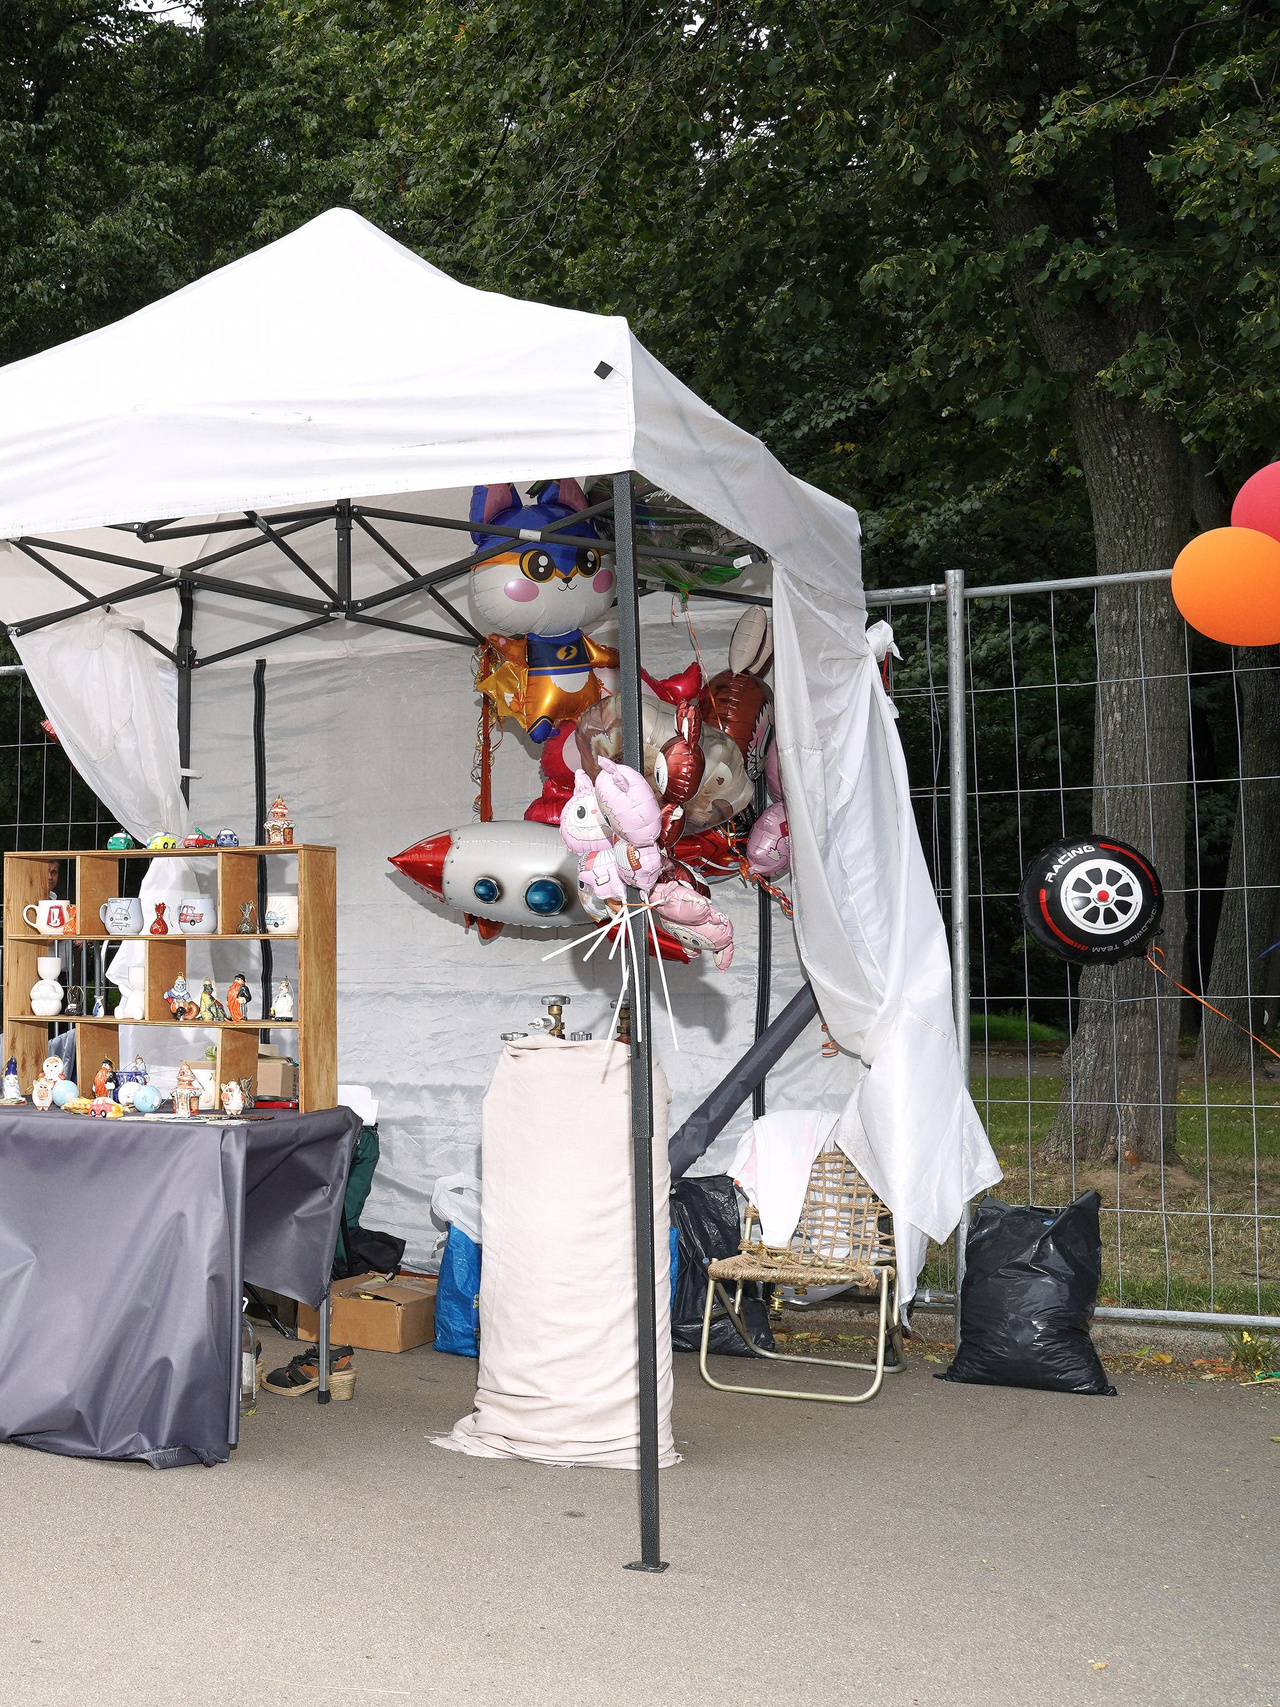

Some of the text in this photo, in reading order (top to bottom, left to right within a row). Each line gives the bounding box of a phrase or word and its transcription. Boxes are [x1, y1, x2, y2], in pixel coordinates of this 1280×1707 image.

[1045, 844, 1096, 883] RACING
[1091, 901, 1159, 953] WORLDWIDE TEAM
